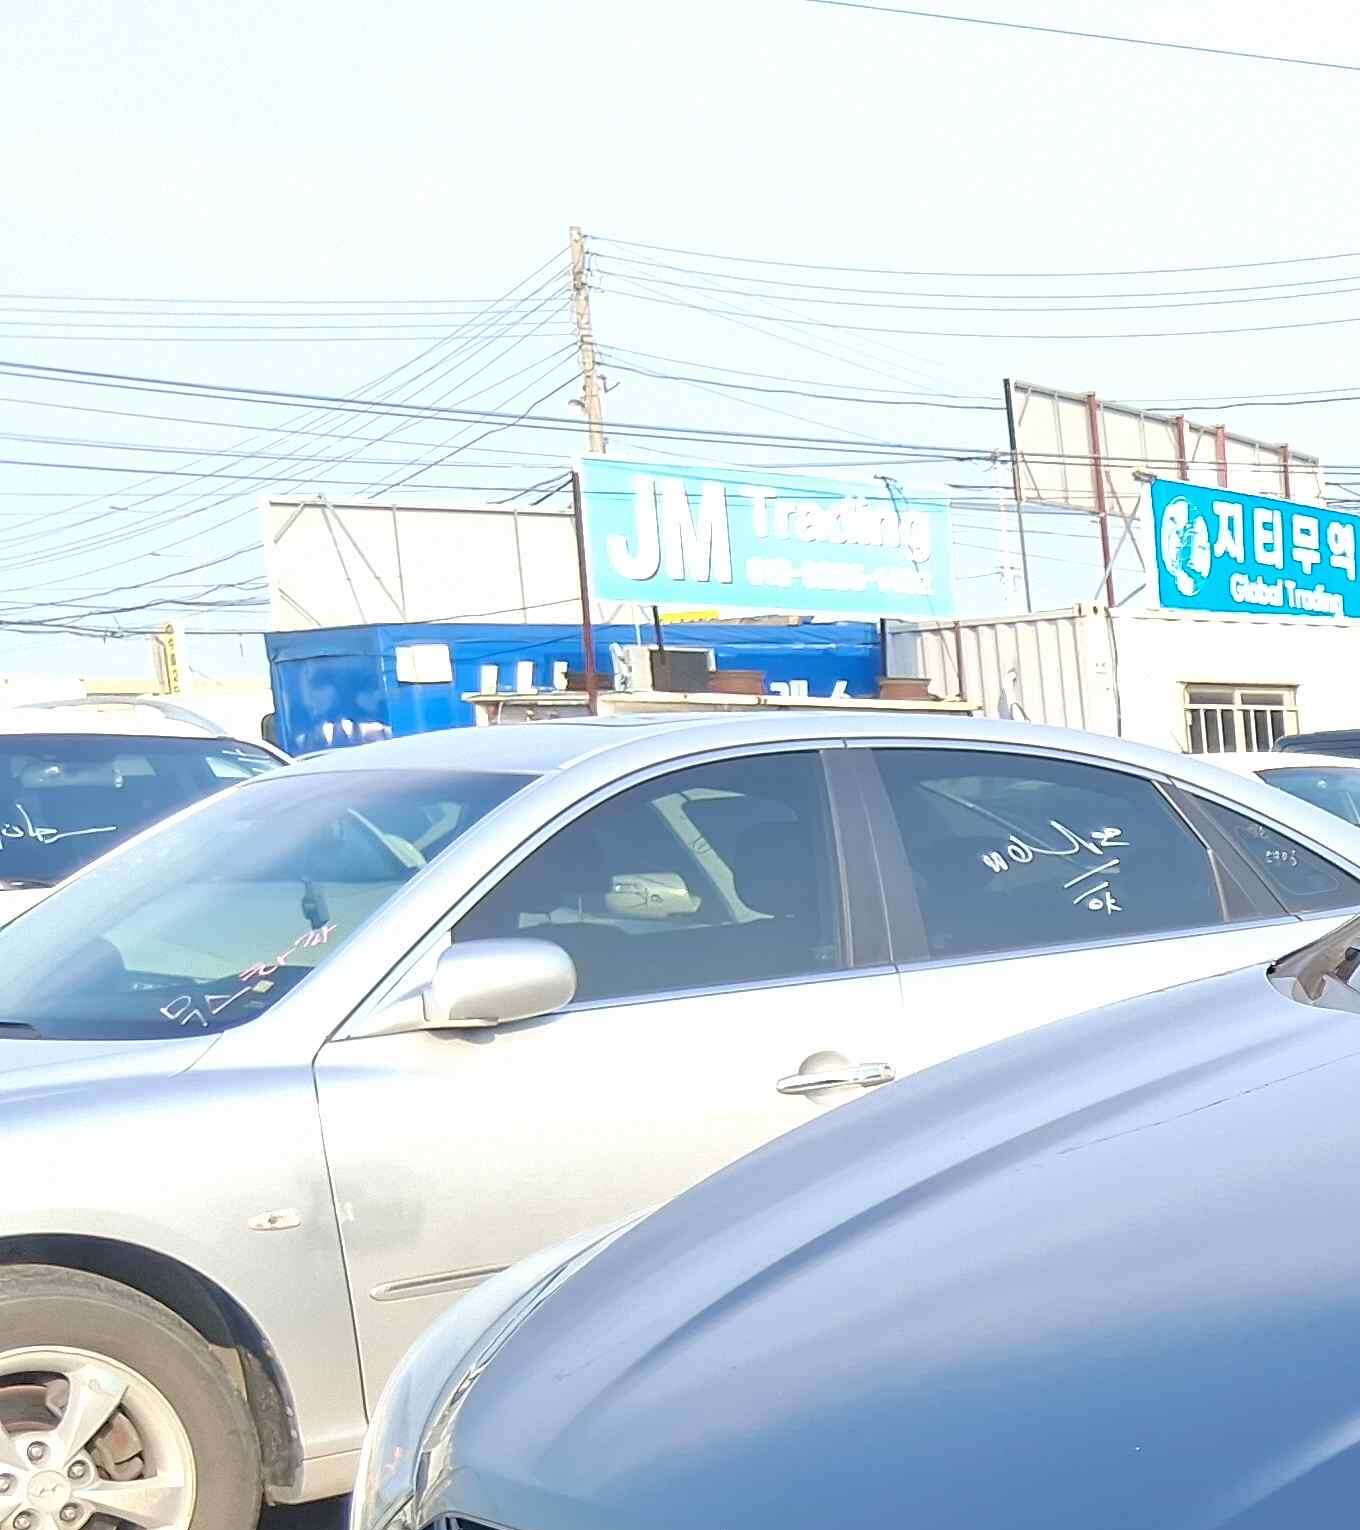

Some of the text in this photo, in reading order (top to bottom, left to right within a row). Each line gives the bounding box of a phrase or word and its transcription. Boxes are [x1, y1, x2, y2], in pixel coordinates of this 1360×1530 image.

[607, 478, 733, 584] JM
[741, 485, 932, 563] Trading
[1230, 573, 1284, 607] Global
[1284, 579, 1345, 619] Trading
